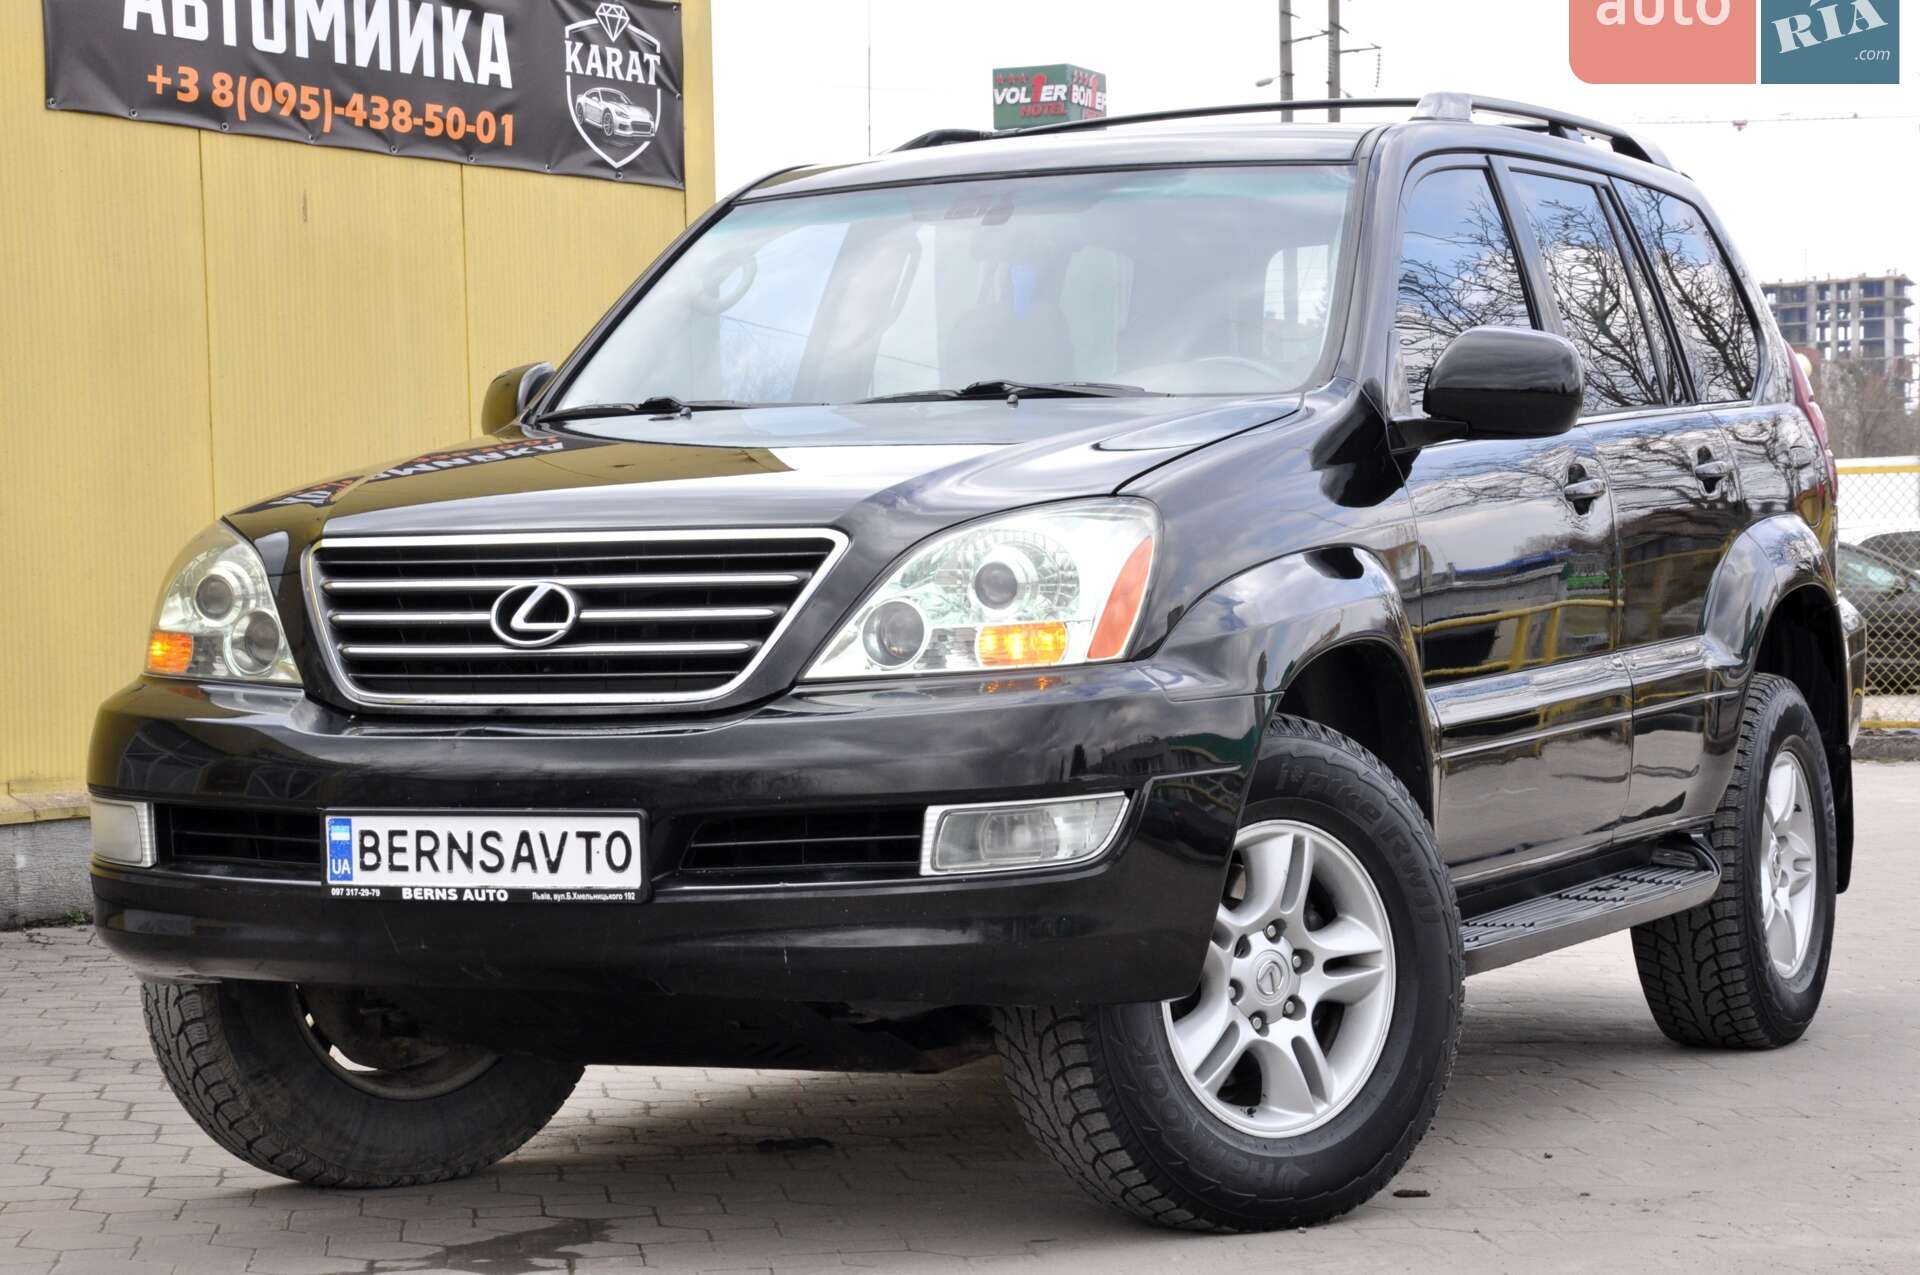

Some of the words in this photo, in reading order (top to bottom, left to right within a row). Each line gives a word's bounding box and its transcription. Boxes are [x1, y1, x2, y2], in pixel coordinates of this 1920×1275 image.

[564, 40, 661, 86] KARAT
[359, 830, 632, 873] BERNSAVTO
[332, 859, 351, 875] UA
[331, 888, 344, 896] 097
[402, 887, 458, 900] BERNS
[463, 889, 508, 901] AUTO
